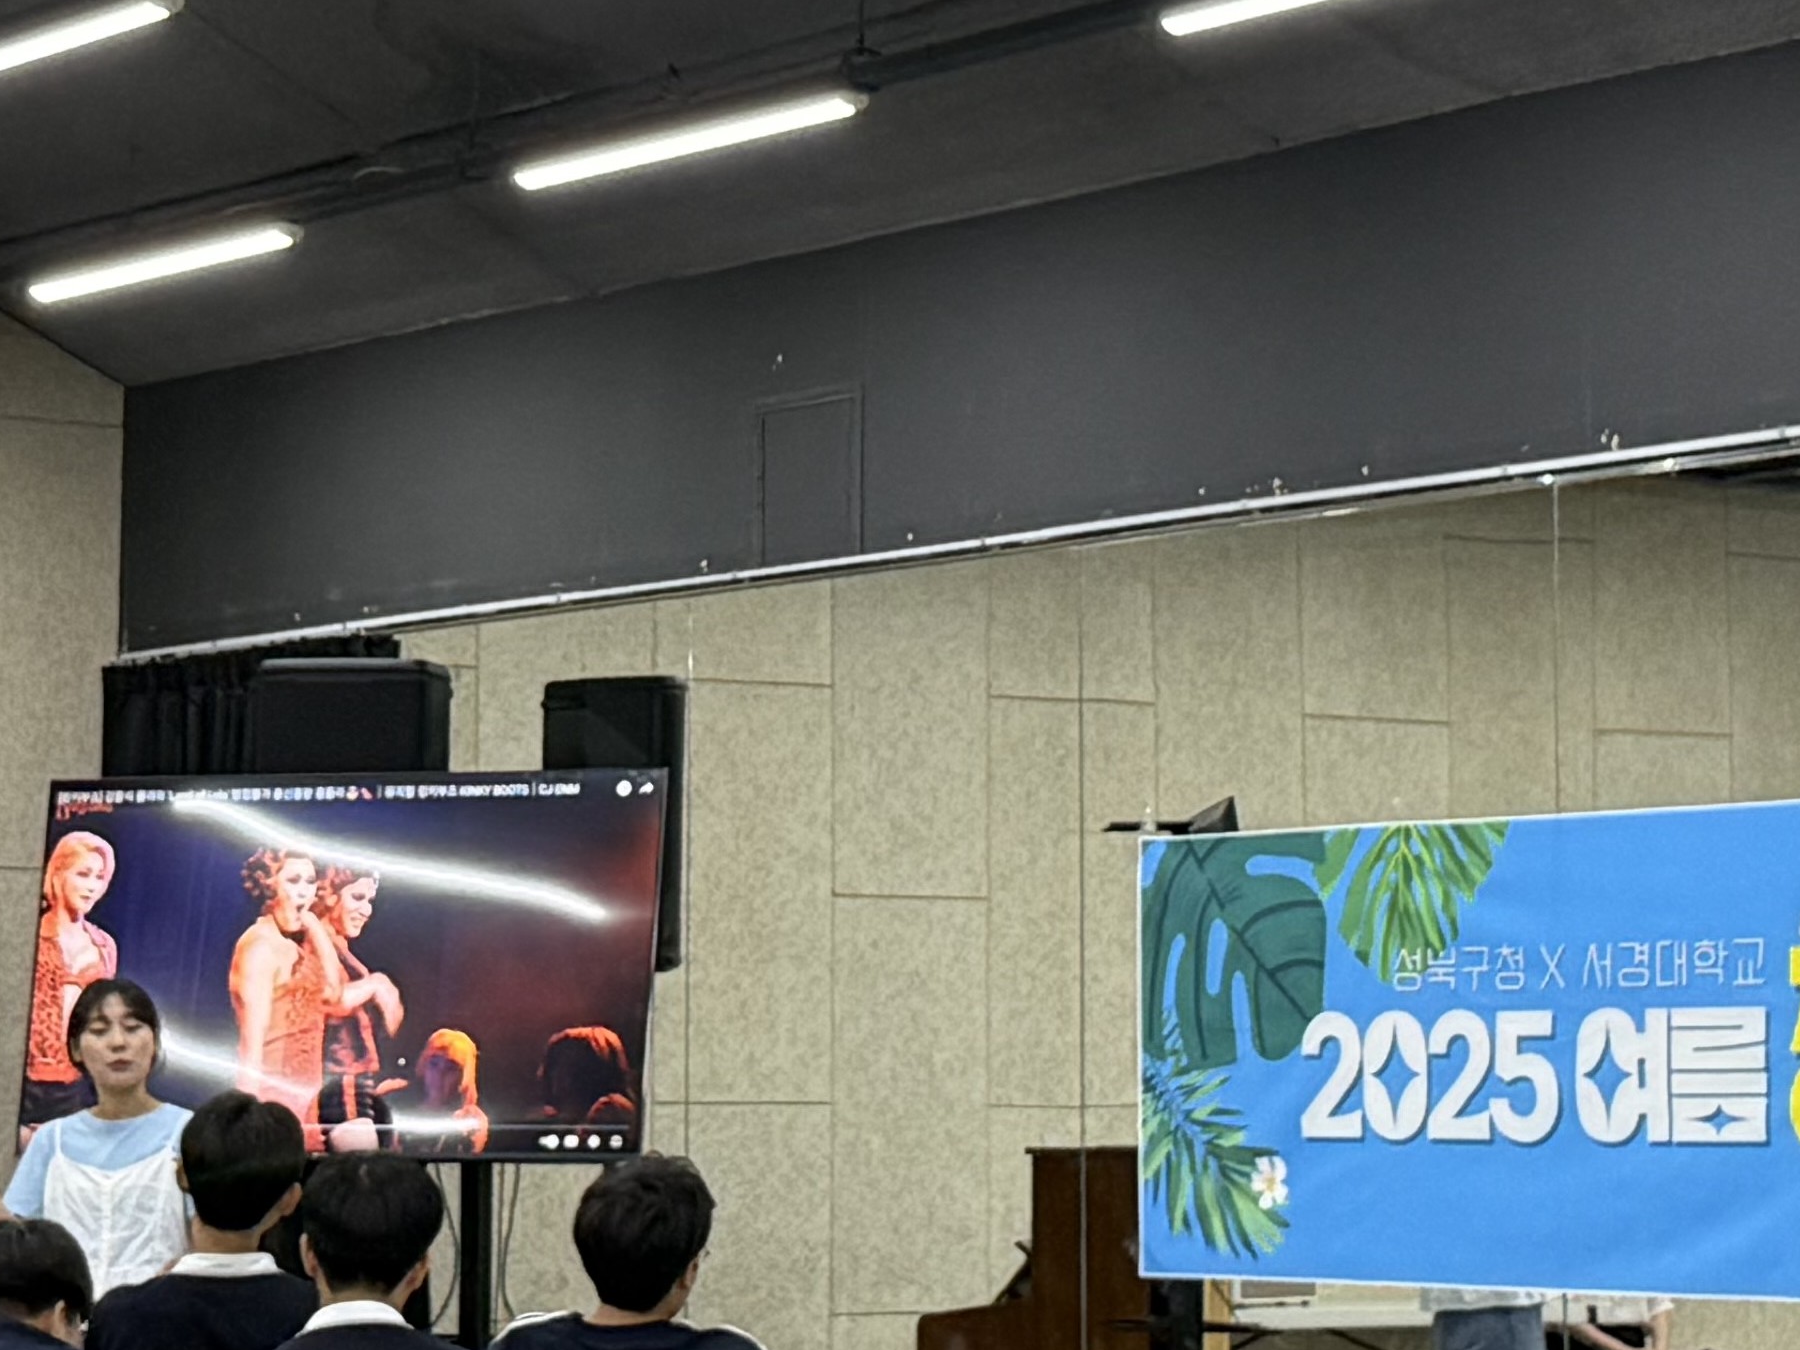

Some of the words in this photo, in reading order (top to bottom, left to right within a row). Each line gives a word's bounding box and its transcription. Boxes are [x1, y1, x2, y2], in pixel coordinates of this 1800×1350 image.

[1392, 942, 1525, 992] 성북구청
[1538, 942, 1566, 990] X
[1581, 936, 1766, 991] 서경대학교
[1301, 1008, 1560, 1143] 2025
[1574, 1005, 1769, 1144] 여름
